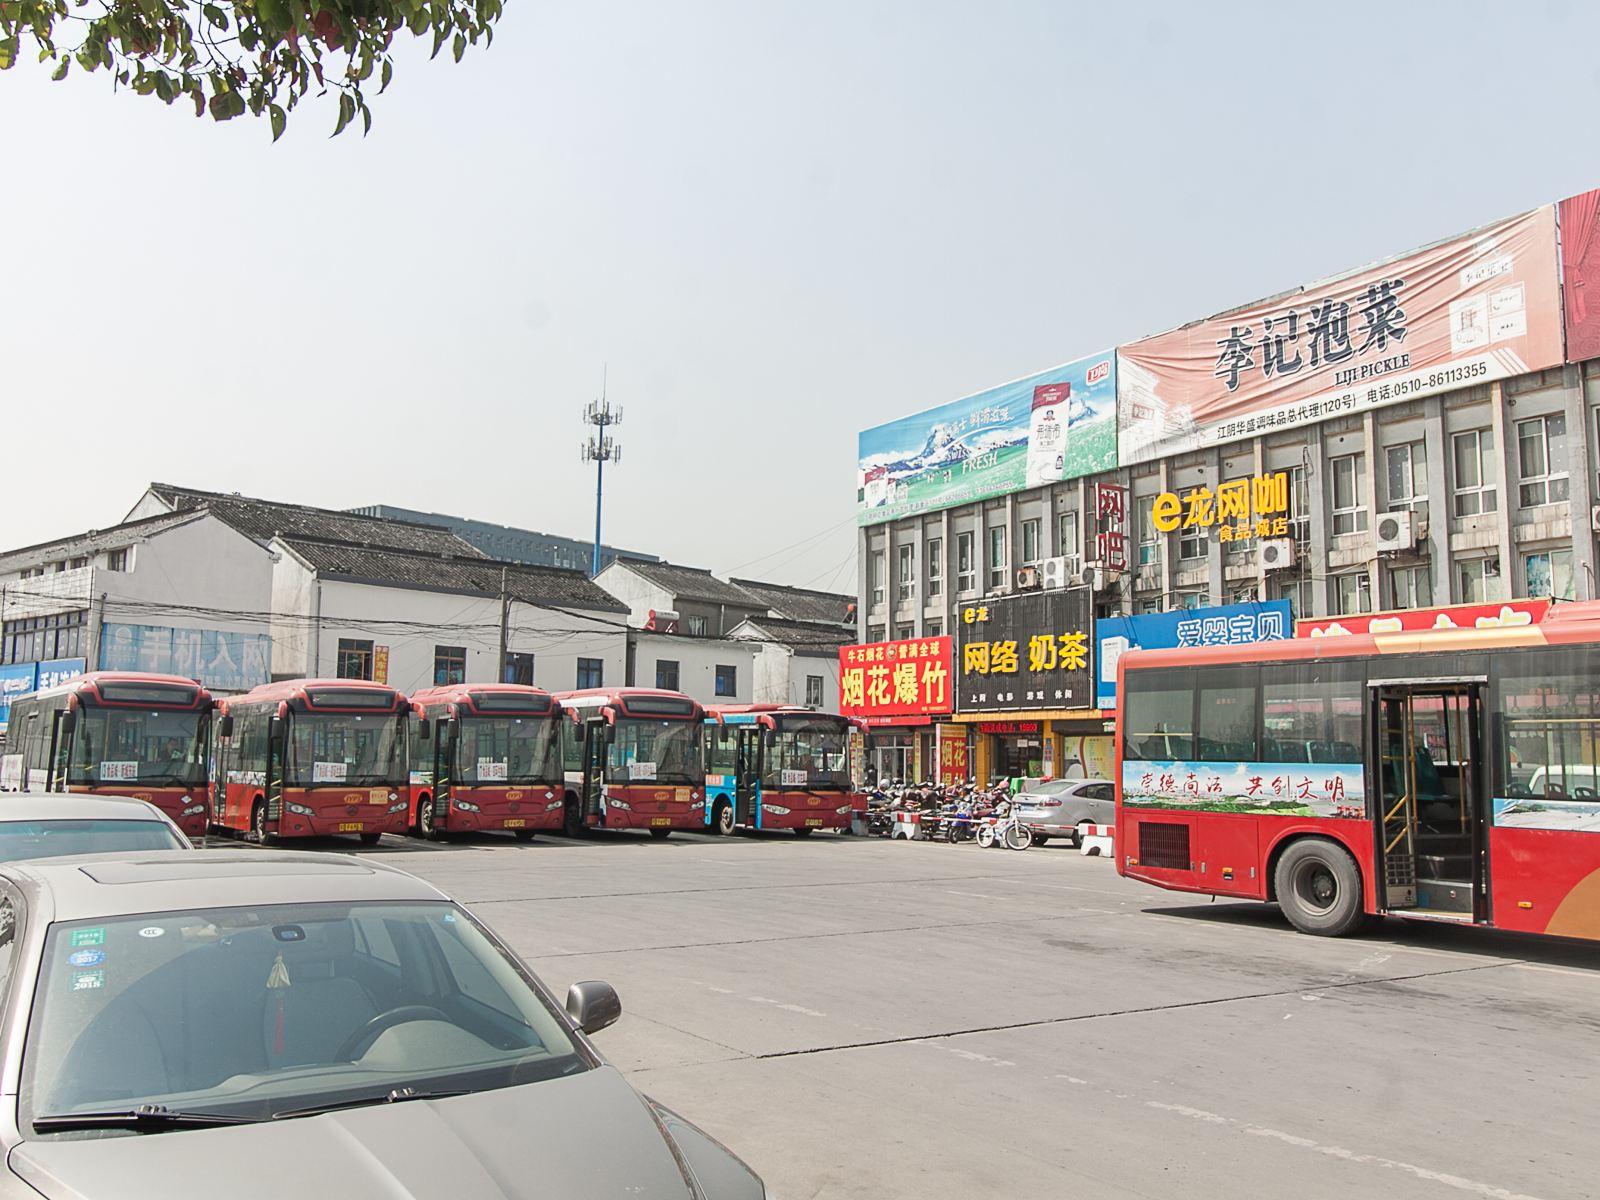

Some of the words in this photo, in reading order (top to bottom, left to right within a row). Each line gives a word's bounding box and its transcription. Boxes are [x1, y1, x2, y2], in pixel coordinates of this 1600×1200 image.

[1214, 278, 1408, 392] 李记泡菜
[1334, 365, 1362, 387] LIJI
[1361, 353, 1411, 379] PICKLE
[1366, 361, 1488, 404] 电话:0510-86113355
[962, 451, 998, 475] FRESH
[1152, 472, 1288, 532] e龙网咖
[1095, 482, 1127, 571] 网吧
[1219, 517, 1289, 543] 食品城店
[964, 606, 990, 624] e龙
[1176, 610, 1285, 648] 爱婴宝贝
[140, 629, 269, 677] 手机入网
[847, 646, 885, 664] 牛石烟花
[898, 640, 940, 660] 誉满全球
[964, 640, 1019, 676] 网络
[1028, 630, 1089, 672] 奶茶
[841, 660, 948, 708] 烟花爆竹
[970, 693, 986, 703] 上网
[996, 692, 1014, 702] 电影
[1054, 689, 1073, 699] 休闲
[941, 739, 966, 768] 烟花
[1140, 771, 1224, 797] 崇德尚法
[1245, 774, 1345, 803] 共创文明
